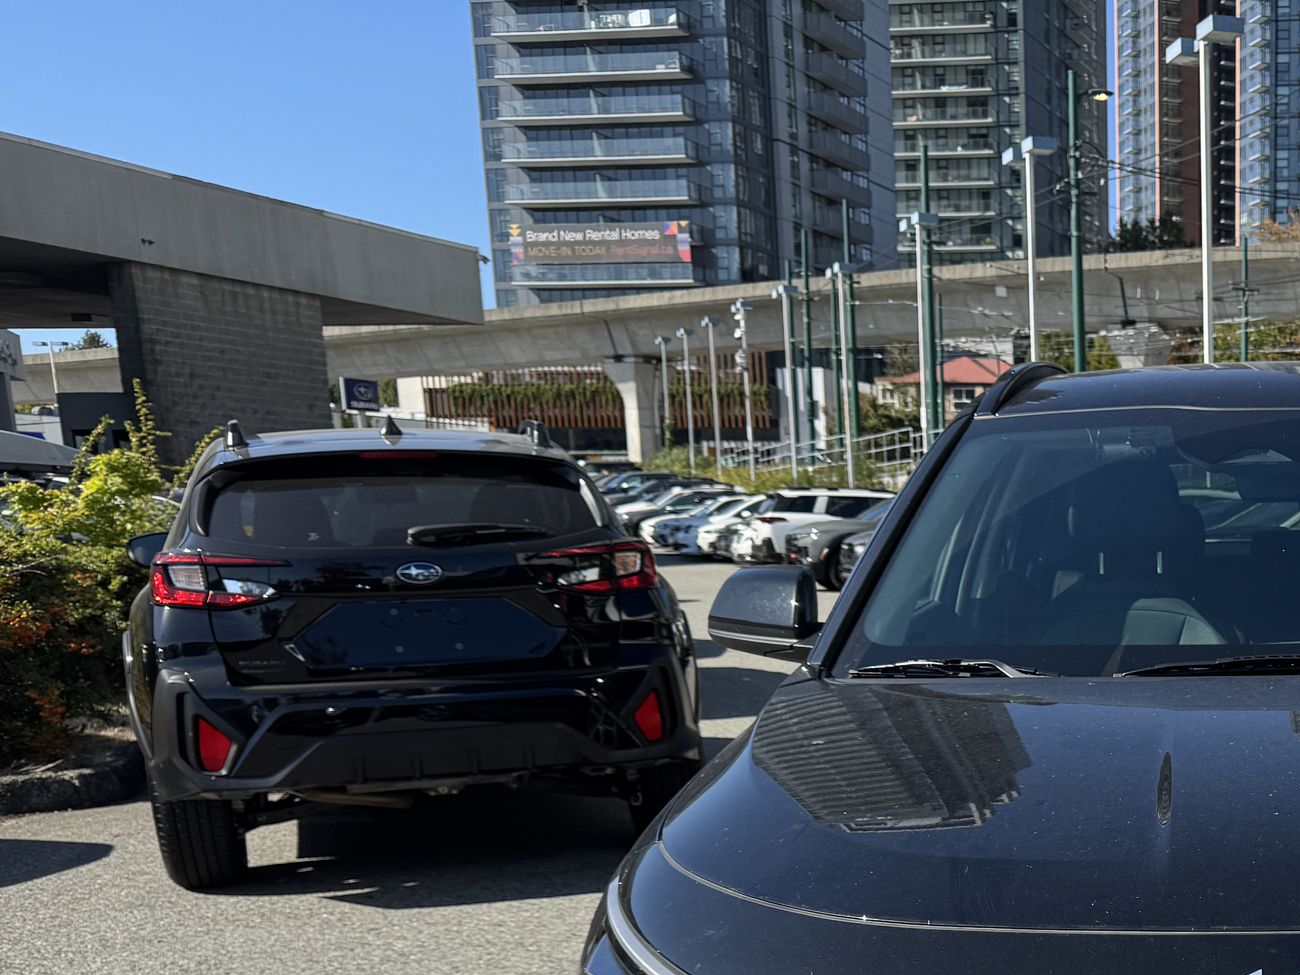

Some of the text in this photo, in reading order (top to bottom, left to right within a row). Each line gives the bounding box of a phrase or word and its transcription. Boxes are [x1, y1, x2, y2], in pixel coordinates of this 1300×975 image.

[526, 228, 661, 242] Brand New Rental Homes
[574, 245, 607, 256] TODAY
